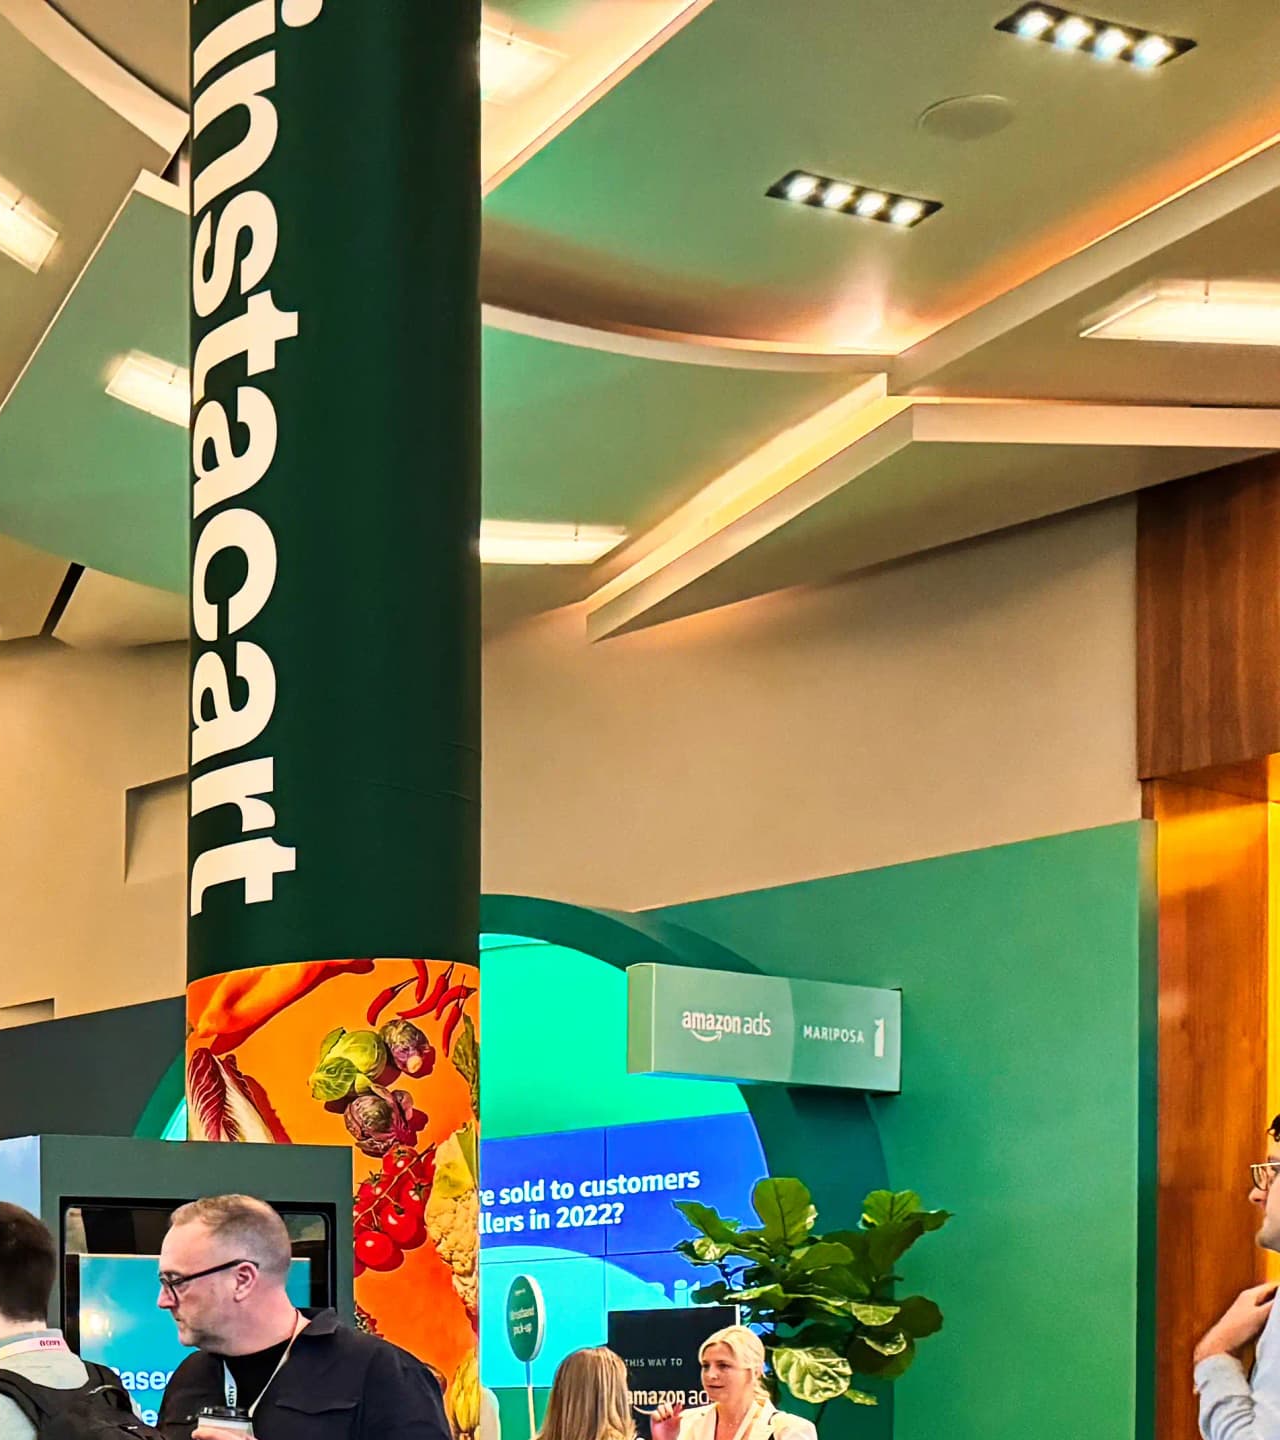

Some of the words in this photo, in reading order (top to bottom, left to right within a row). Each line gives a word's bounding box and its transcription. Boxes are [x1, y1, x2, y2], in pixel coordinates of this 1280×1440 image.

[190, 0, 323, 916] instacart
[681, 1011, 741, 1032] amazon
[744, 1011, 772, 1037] ads
[803, 1024, 865, 1043] MARIPOSA
[499, 1179, 545, 1205] sold
[550, 1180, 575, 1200] to
[579, 1170, 701, 1197] customers
[529, 1208, 550, 1230] in
[556, 1202, 625, 1228] 2022?
[648, 1357, 667, 1367] WAY
[670, 1358, 683, 1367] TO
[110, 1366, 176, 1391] ase
